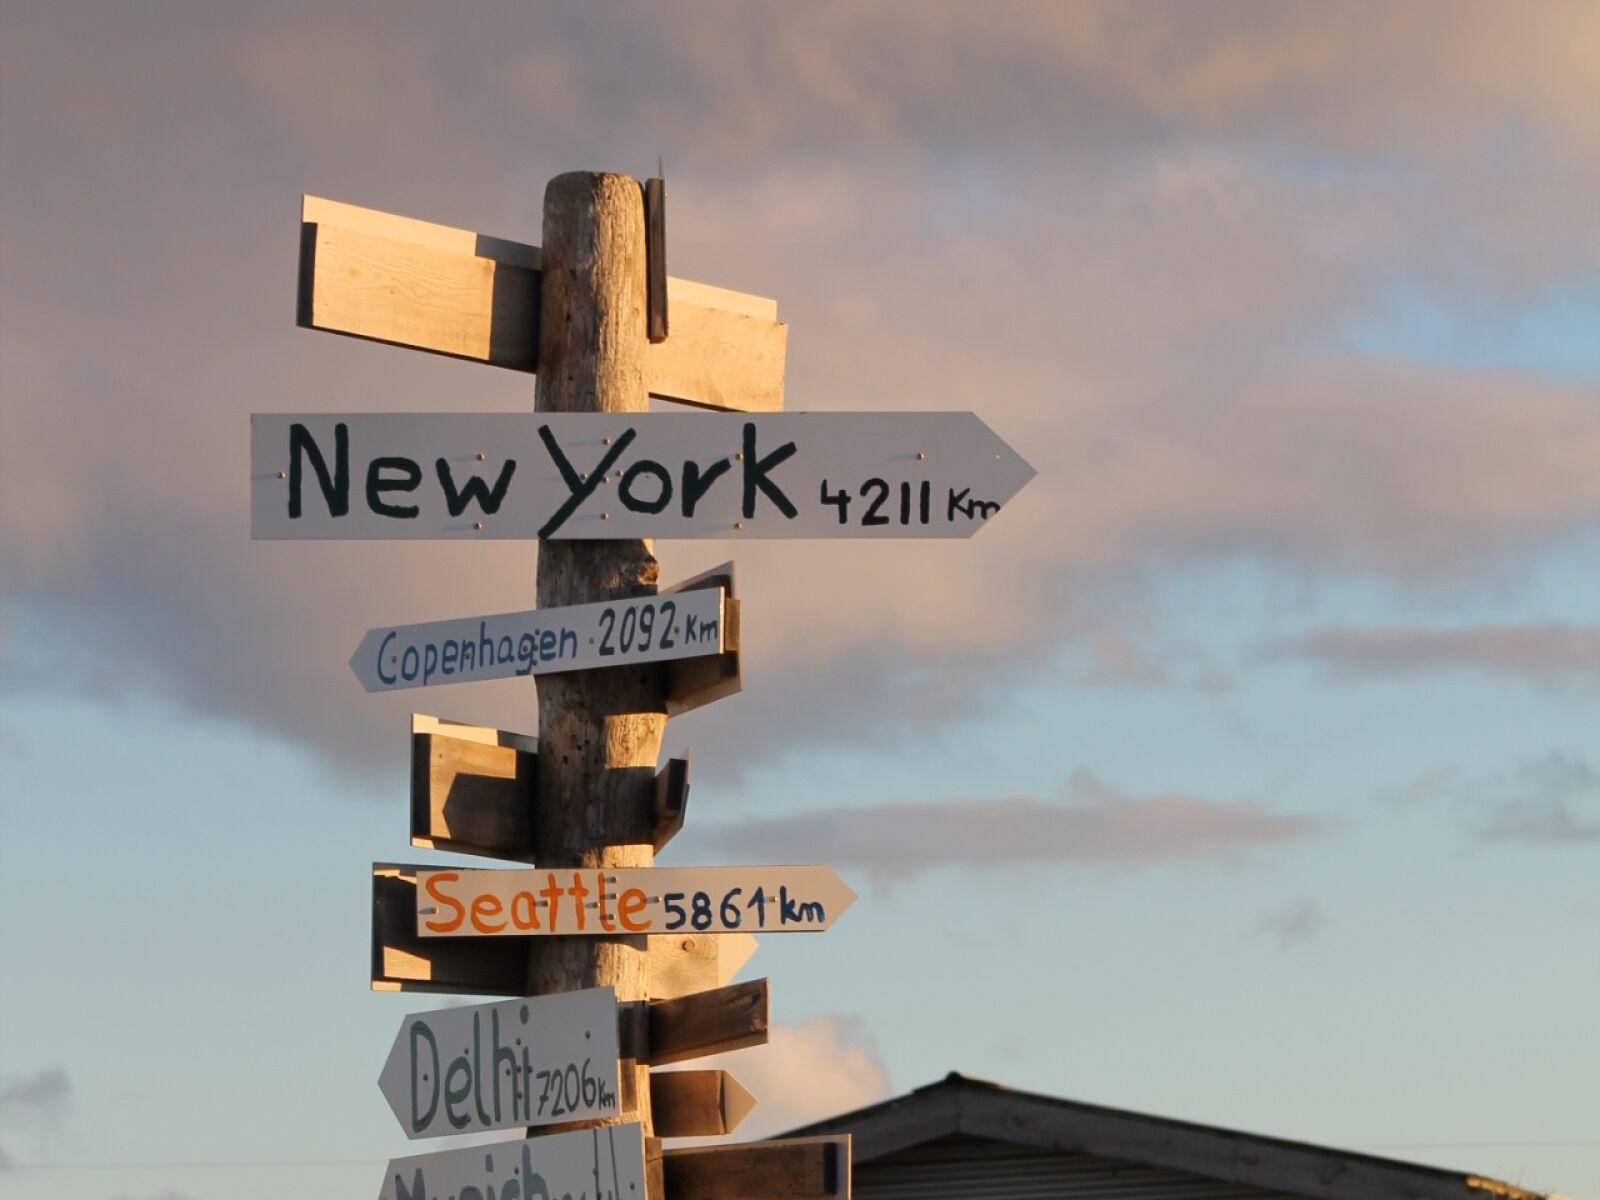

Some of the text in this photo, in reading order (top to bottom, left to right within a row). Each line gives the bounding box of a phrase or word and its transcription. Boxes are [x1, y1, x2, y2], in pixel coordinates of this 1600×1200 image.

[288, 423, 516, 519] New
[537, 423, 799, 540] York
[819, 477, 931, 525] 4211
[377, 620, 578, 687] Copenhagen
[598, 601, 678, 656] 2092
[425, 872, 826, 933] Seattle 5861 km
[410, 1004, 531, 1133] Delhi
[536, 1057, 597, 1117] 7206
